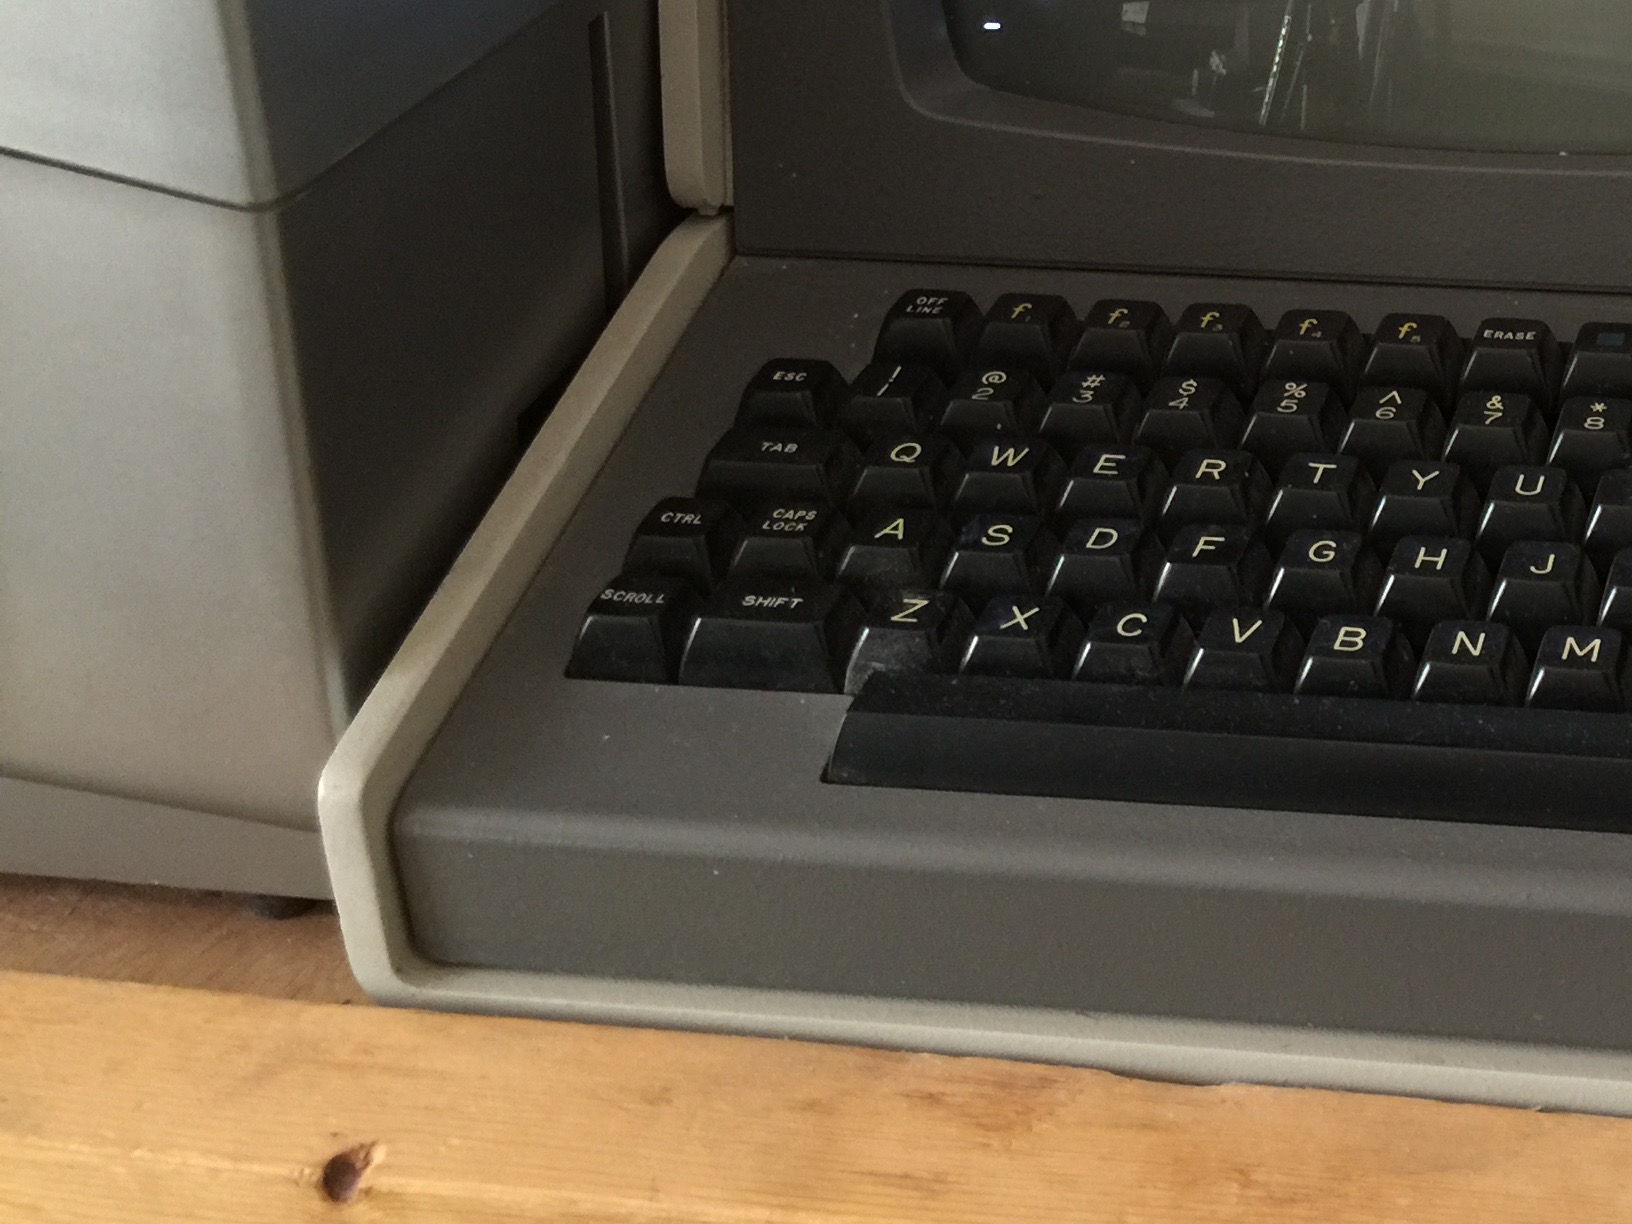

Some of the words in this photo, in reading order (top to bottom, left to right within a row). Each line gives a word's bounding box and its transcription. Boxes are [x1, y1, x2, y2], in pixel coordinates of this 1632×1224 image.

[905, 304, 943, 315] LINE
[916, 296, 948, 307] OFF
[1483, 329, 1536, 340] ERASE
[772, 371, 807, 382] ESC
[981, 370, 1007, 385] @
[971, 387, 995, 401] 2
[1072, 389, 1095, 404] 3
[1178, 378, 1198, 397] $
[1283, 381, 1308, 398] %
[1168, 397, 1189, 410] 4
[1276, 398, 1299, 413] 5
[1486, 395, 1504, 410] &
[1375, 406, 1397, 420] 6
[1483, 410, 1503, 425] 7
[1583, 416, 1605, 430] 8
[761, 441, 799, 453] TAB
[889, 442, 922, 463] Q
[990, 445, 1030, 467] W
[1092, 453, 1126, 475] E
[1195, 458, 1227, 480] R
[1308, 462, 1337, 484] T
[1411, 469, 1440, 491] Y
[1514, 473, 1545, 496] U
[660, 511, 702, 525] CTRL
[772, 508, 818, 521] CAPS
[761, 520, 808, 532] LOCK
[874, 518, 905, 540] A
[981, 524, 1013, 546] S
[1085, 527, 1119, 549] D
[1192, 536, 1226, 558] F
[1308, 540, 1337, 563] G
[1414, 546, 1448, 571] H
[1529, 553, 1556, 574] J
[599, 588, 665, 604] SCROLL
[742, 595, 804, 609] SHIFT
[890, 598, 929, 623] Z
[999, 605, 1040, 631] X
[1116, 612, 1148, 637] C
[1232, 617, 1263, 643] V
[1333, 626, 1367, 652] B
[1451, 630, 1486, 657] N
[1561, 636, 1602, 663] M
